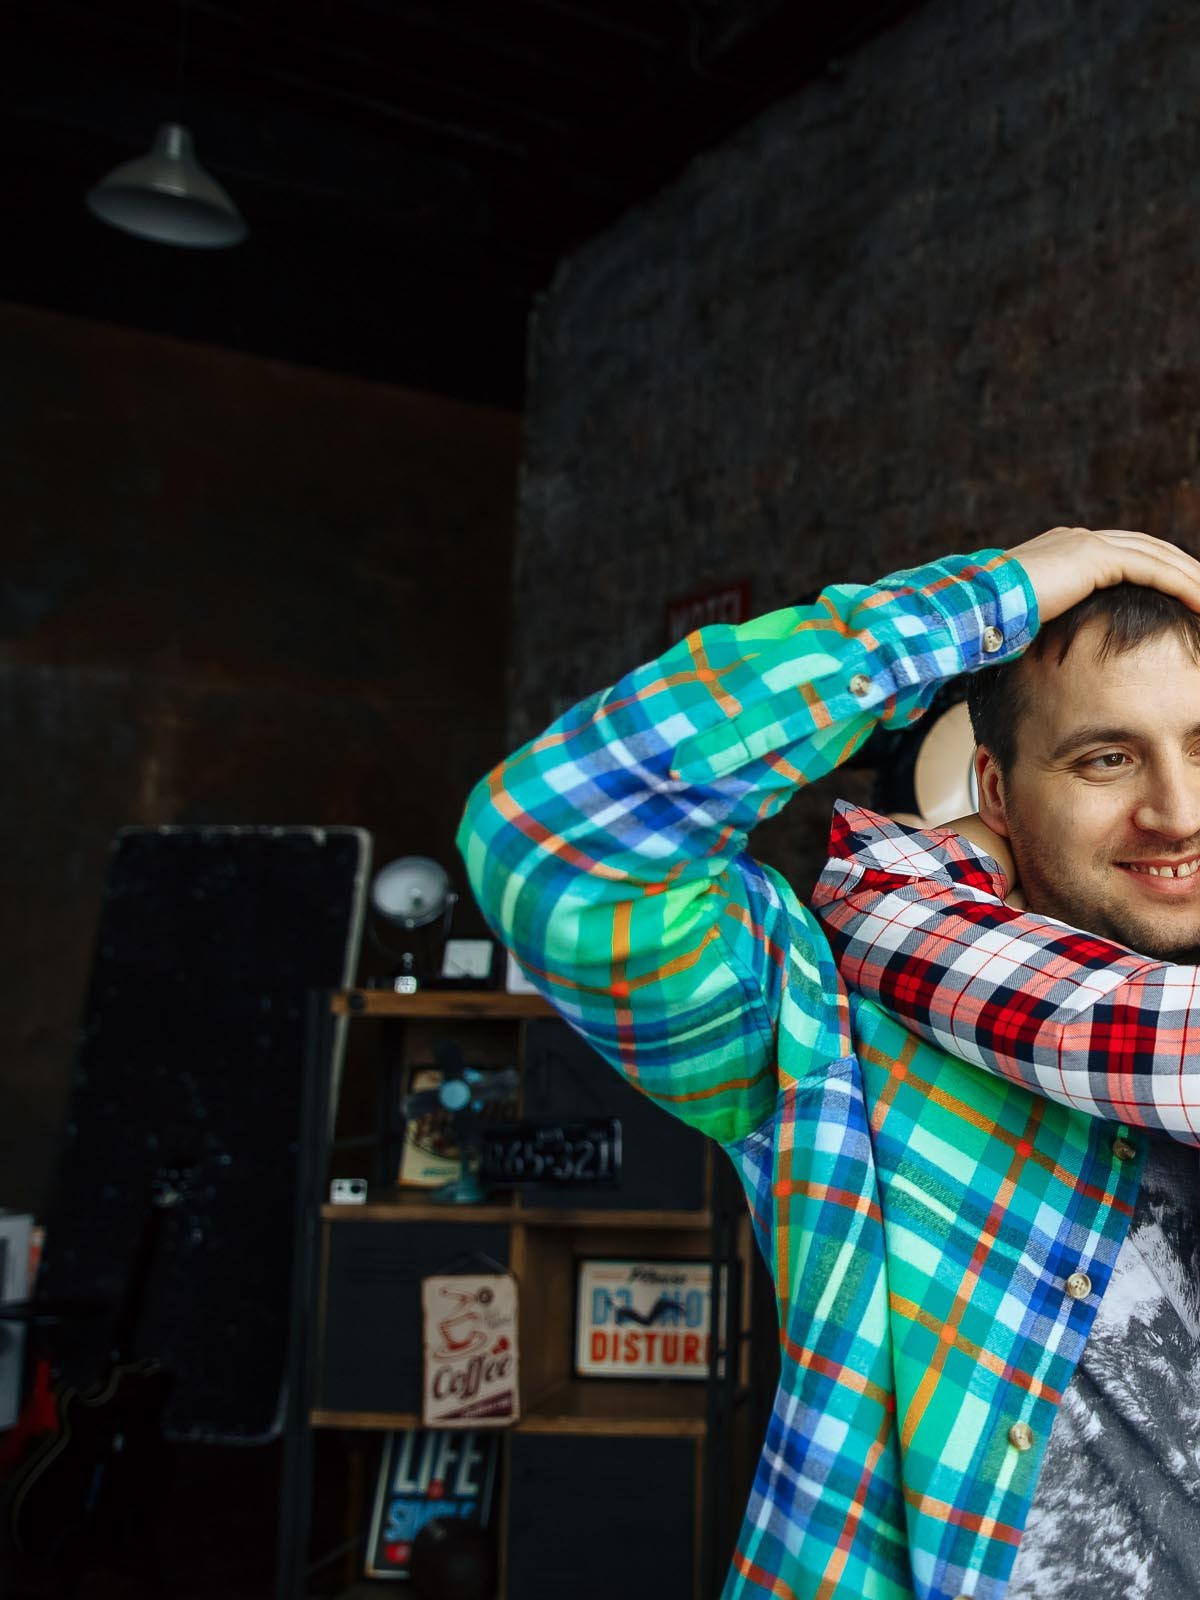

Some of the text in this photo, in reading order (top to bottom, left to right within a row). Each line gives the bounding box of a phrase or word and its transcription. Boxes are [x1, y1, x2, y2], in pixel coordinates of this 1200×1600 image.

[660, 1289, 714, 1328] NO
[434, 1356, 512, 1399] Coffee
[393, 1430, 483, 1494] LIFE
